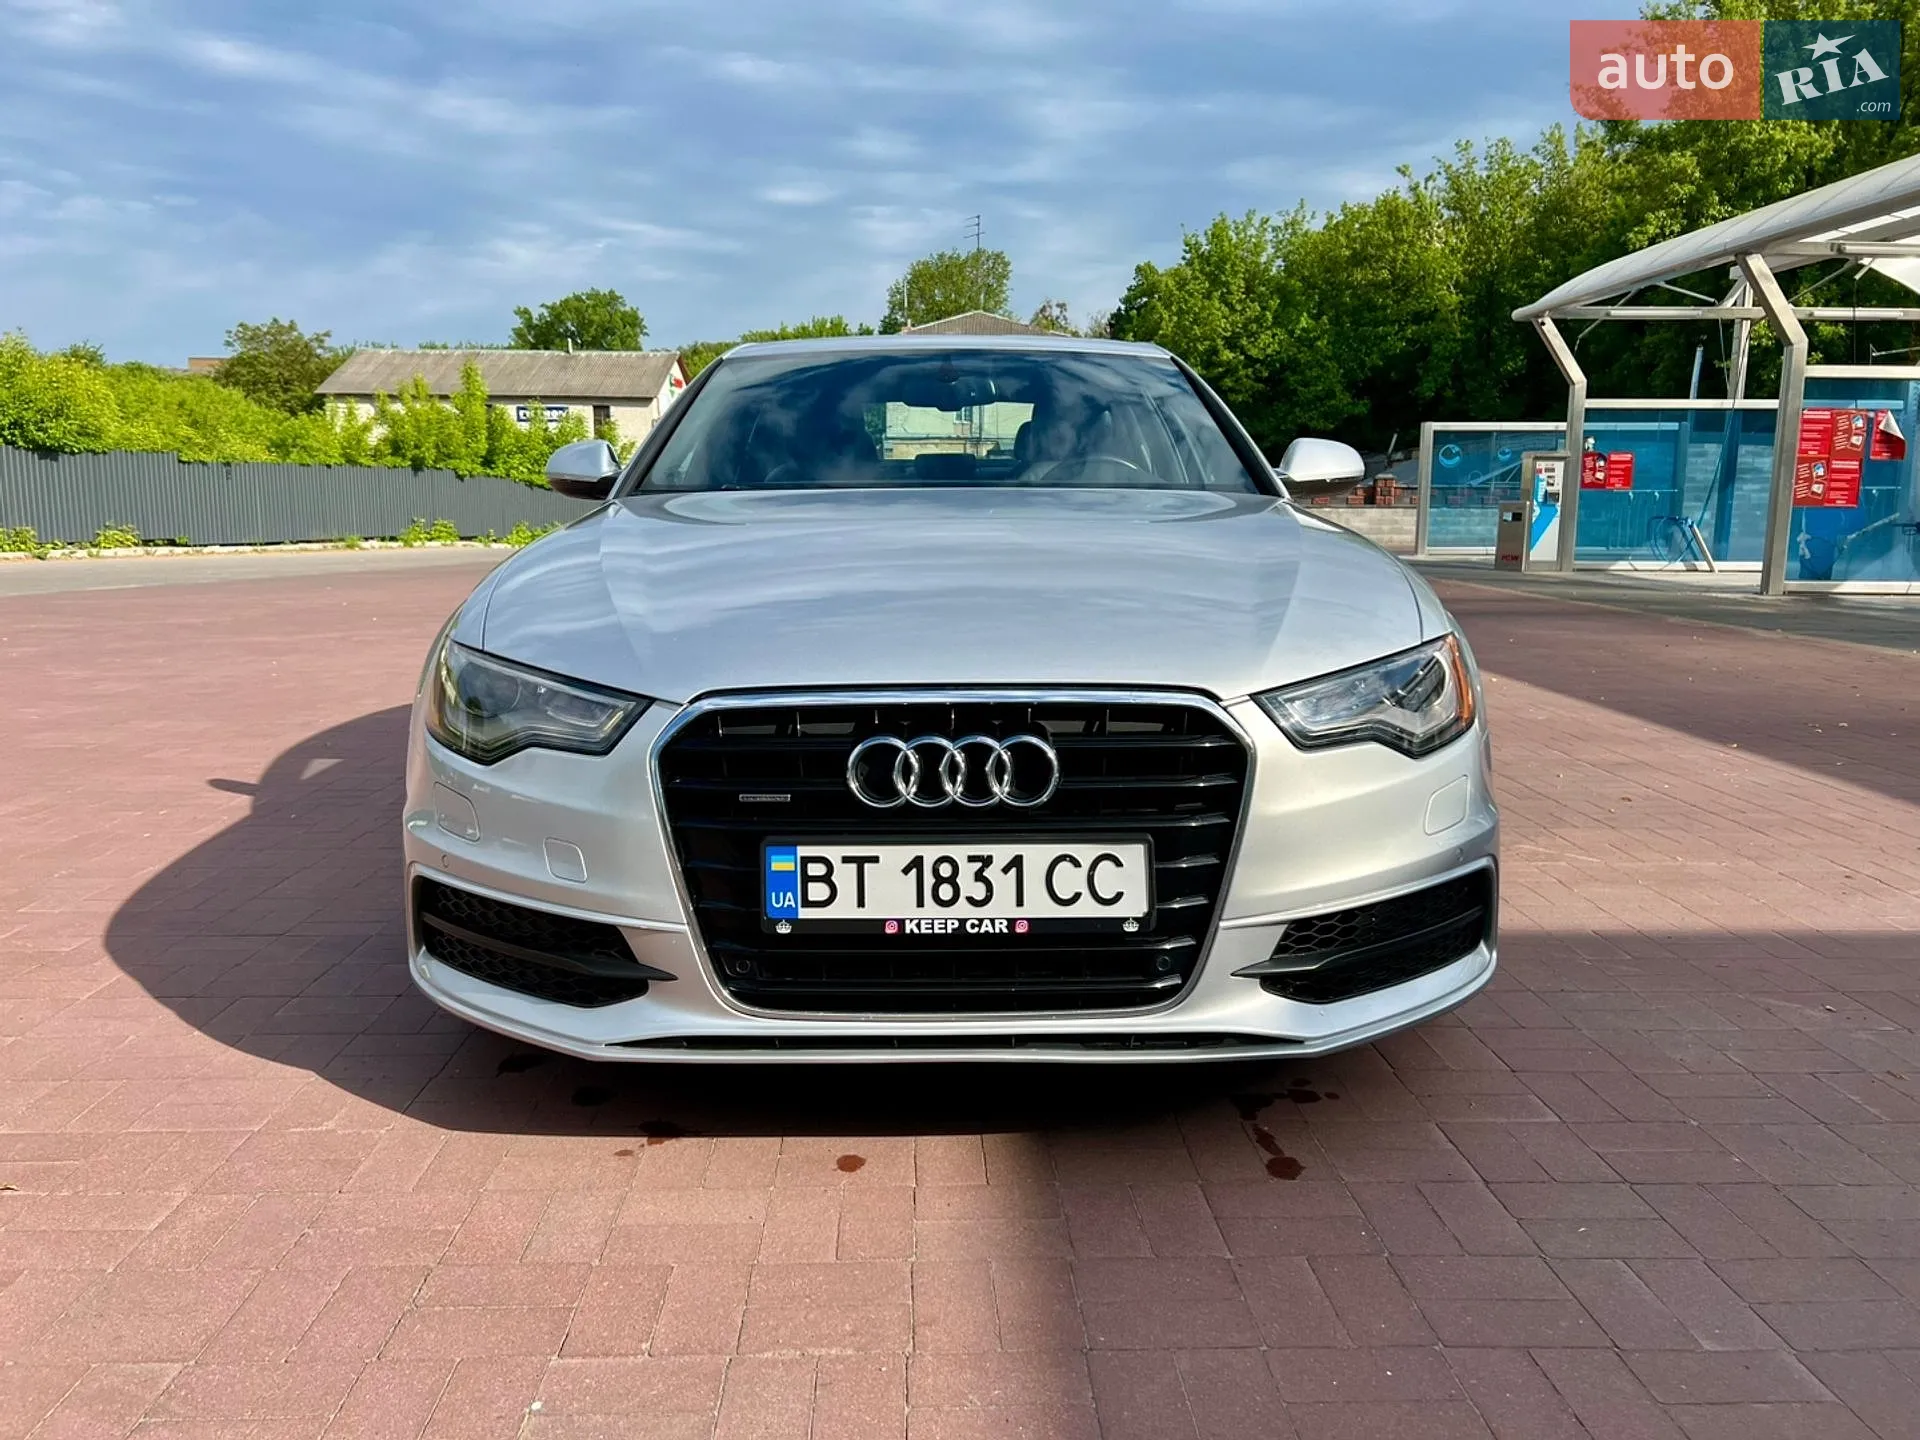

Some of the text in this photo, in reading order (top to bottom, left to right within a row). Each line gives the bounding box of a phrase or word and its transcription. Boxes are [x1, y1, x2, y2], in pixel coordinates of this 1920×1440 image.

[801, 853, 1125, 908] BT 1831 CC
[771, 891, 796, 908] UA
[904, 919, 1009, 934] KEEP CAR
